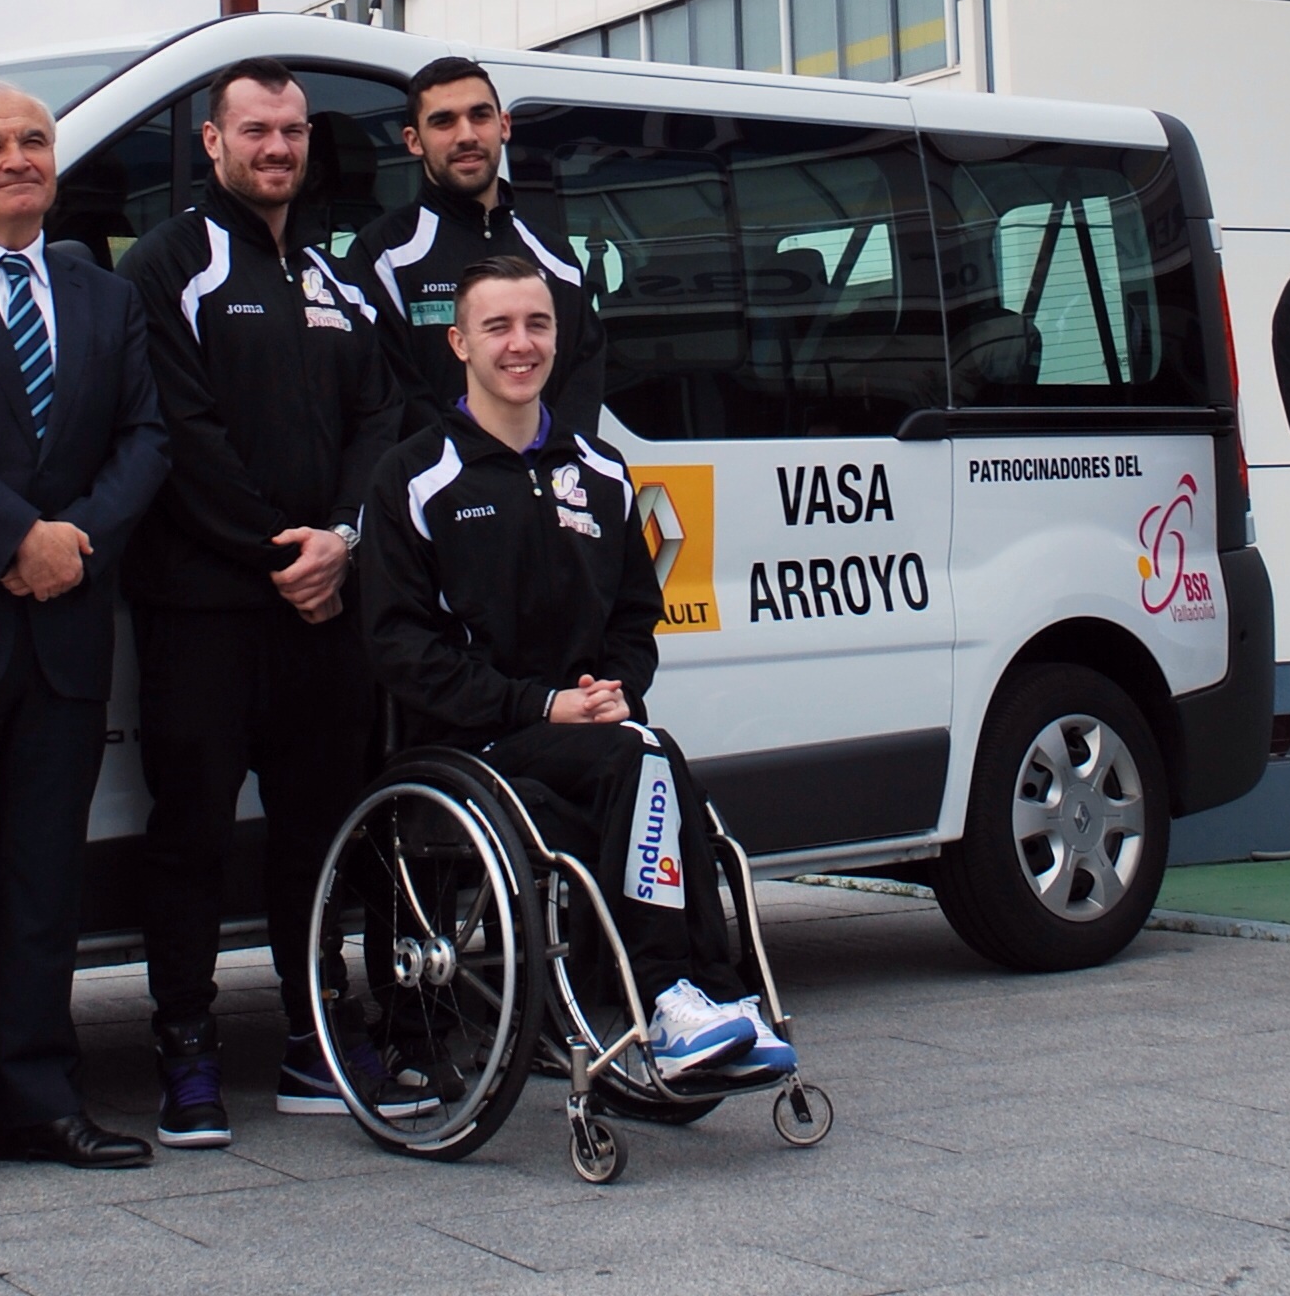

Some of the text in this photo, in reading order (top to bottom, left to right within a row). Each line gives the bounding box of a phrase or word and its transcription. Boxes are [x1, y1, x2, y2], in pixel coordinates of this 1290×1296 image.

[969, 455, 1143, 482] PATROCINADORES DEL
[776, 463, 895, 526] VASA
[750, 552, 929, 623] ARROYO
[1183, 573, 1212, 602] BSR
[659, 602, 709, 625] AULT
[1169, 601, 1216, 623] Valladolid
[637, 779, 667, 900] campus
